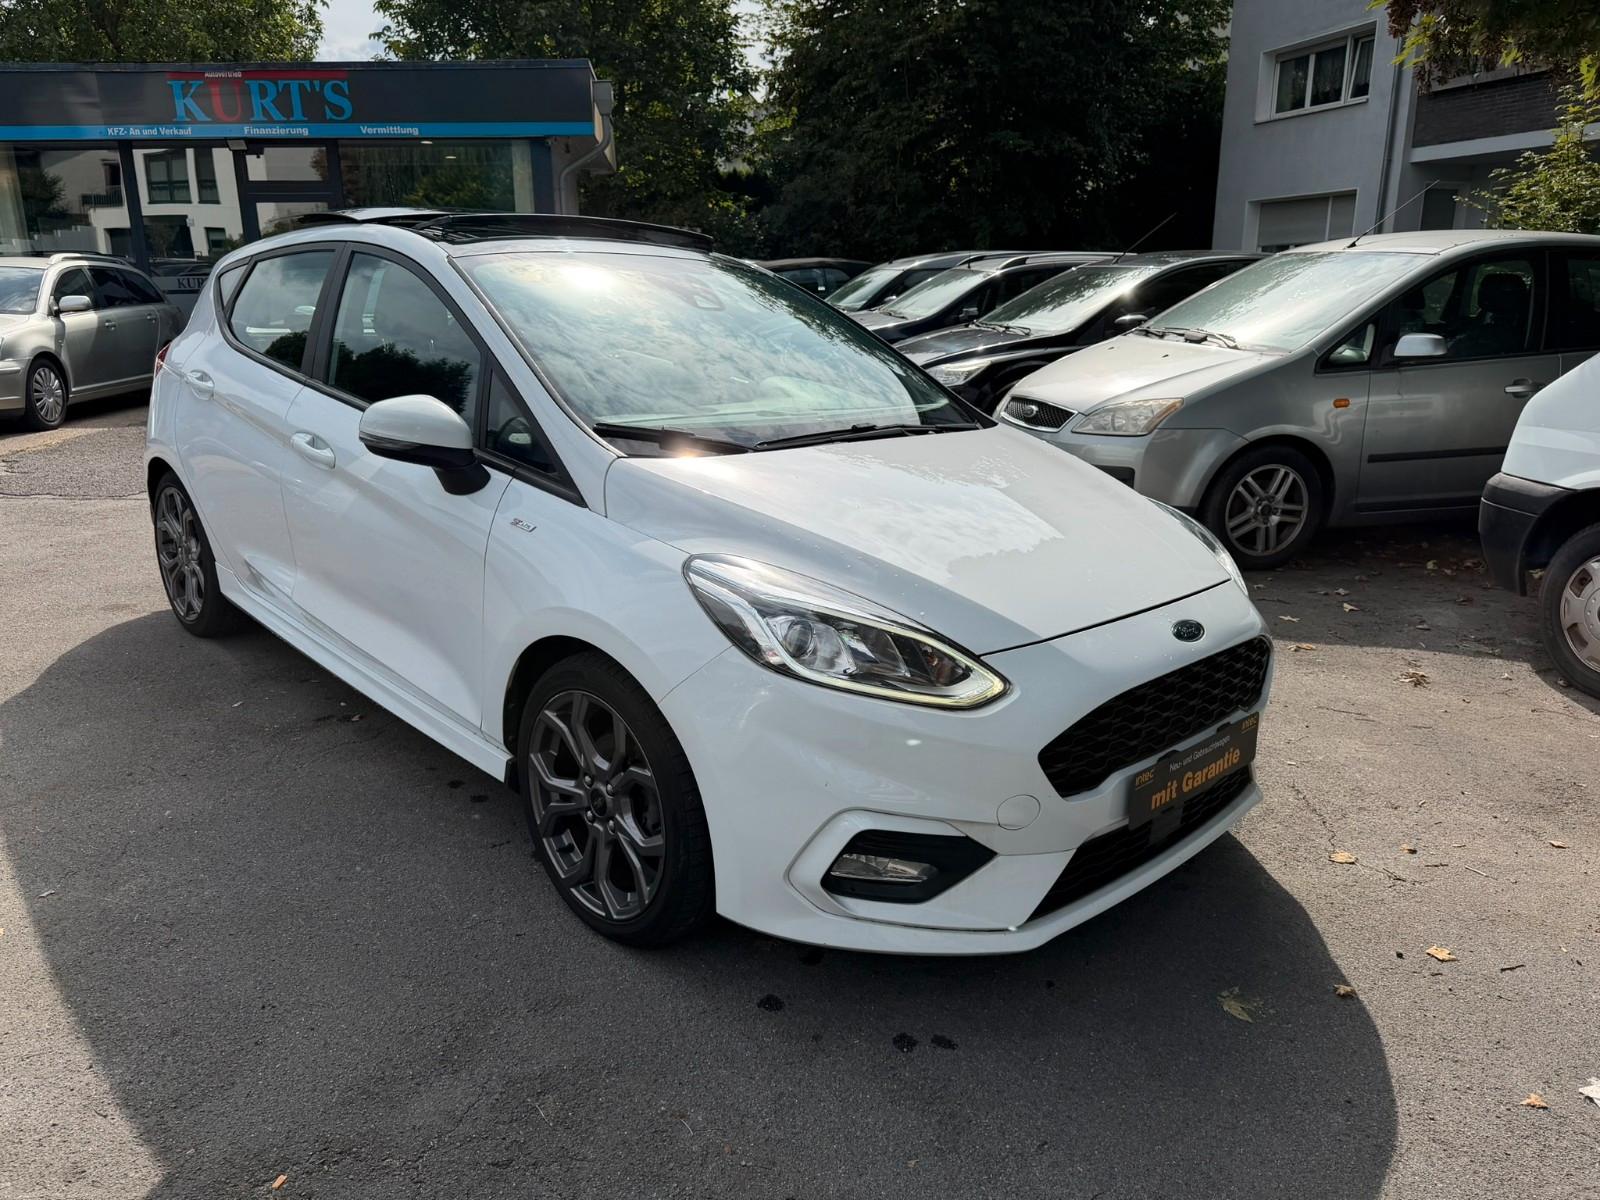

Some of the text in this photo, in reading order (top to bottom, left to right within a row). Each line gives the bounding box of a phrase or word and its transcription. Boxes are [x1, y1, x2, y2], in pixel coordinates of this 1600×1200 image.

[167, 79, 353, 122] KURT'S
[107, 126, 192, 136] KFZ- An und Verkauf
[244, 126, 309, 137] Finanzierung
[360, 125, 419, 136] Vermittlung
[1151, 747, 1241, 811] mit Garantie
